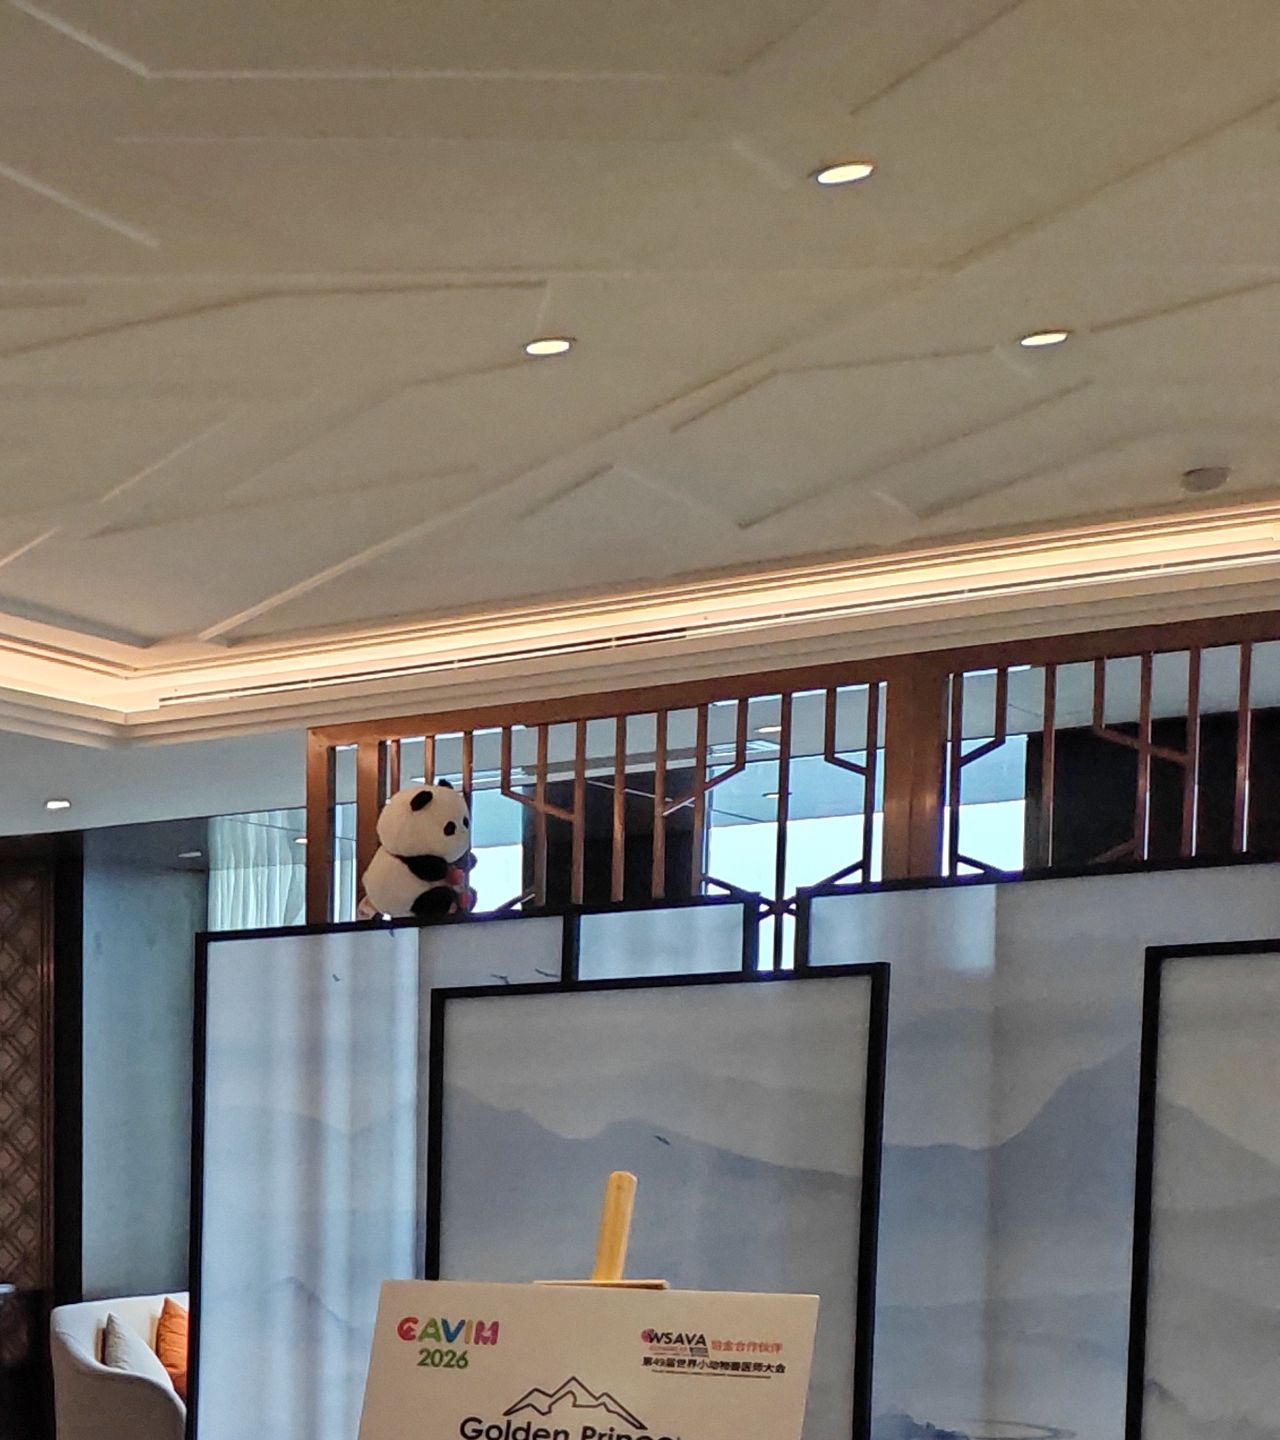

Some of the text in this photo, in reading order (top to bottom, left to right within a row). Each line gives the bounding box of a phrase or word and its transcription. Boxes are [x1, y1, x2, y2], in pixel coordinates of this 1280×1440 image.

[397, 1316, 500, 1346] CAVIM
[647, 1331, 708, 1347] WSAVA
[417, 1348, 470, 1370] 2026
